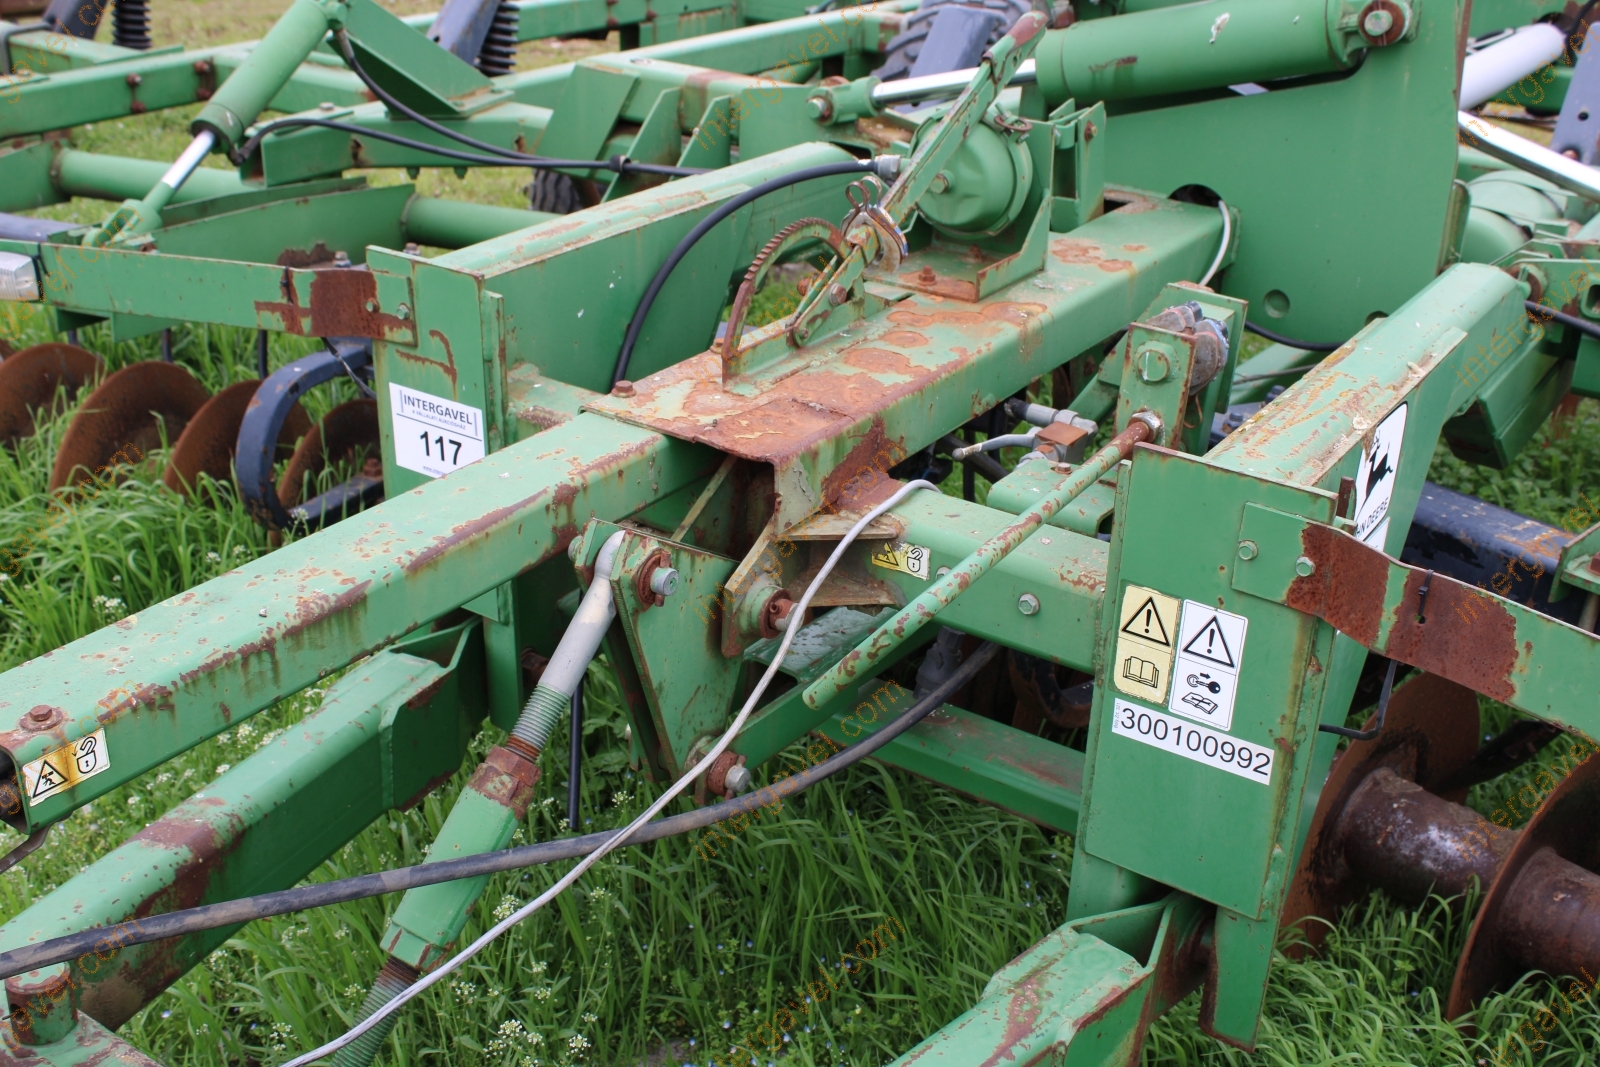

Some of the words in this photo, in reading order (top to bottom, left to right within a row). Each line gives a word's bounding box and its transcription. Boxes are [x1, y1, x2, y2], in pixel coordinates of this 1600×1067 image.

[403, 394, 473, 425] INTERGAVEL
[420, 431, 462, 466] 117
[1366, 496, 1389, 528] DEERE
[1121, 707, 1271, 776] 300100992
